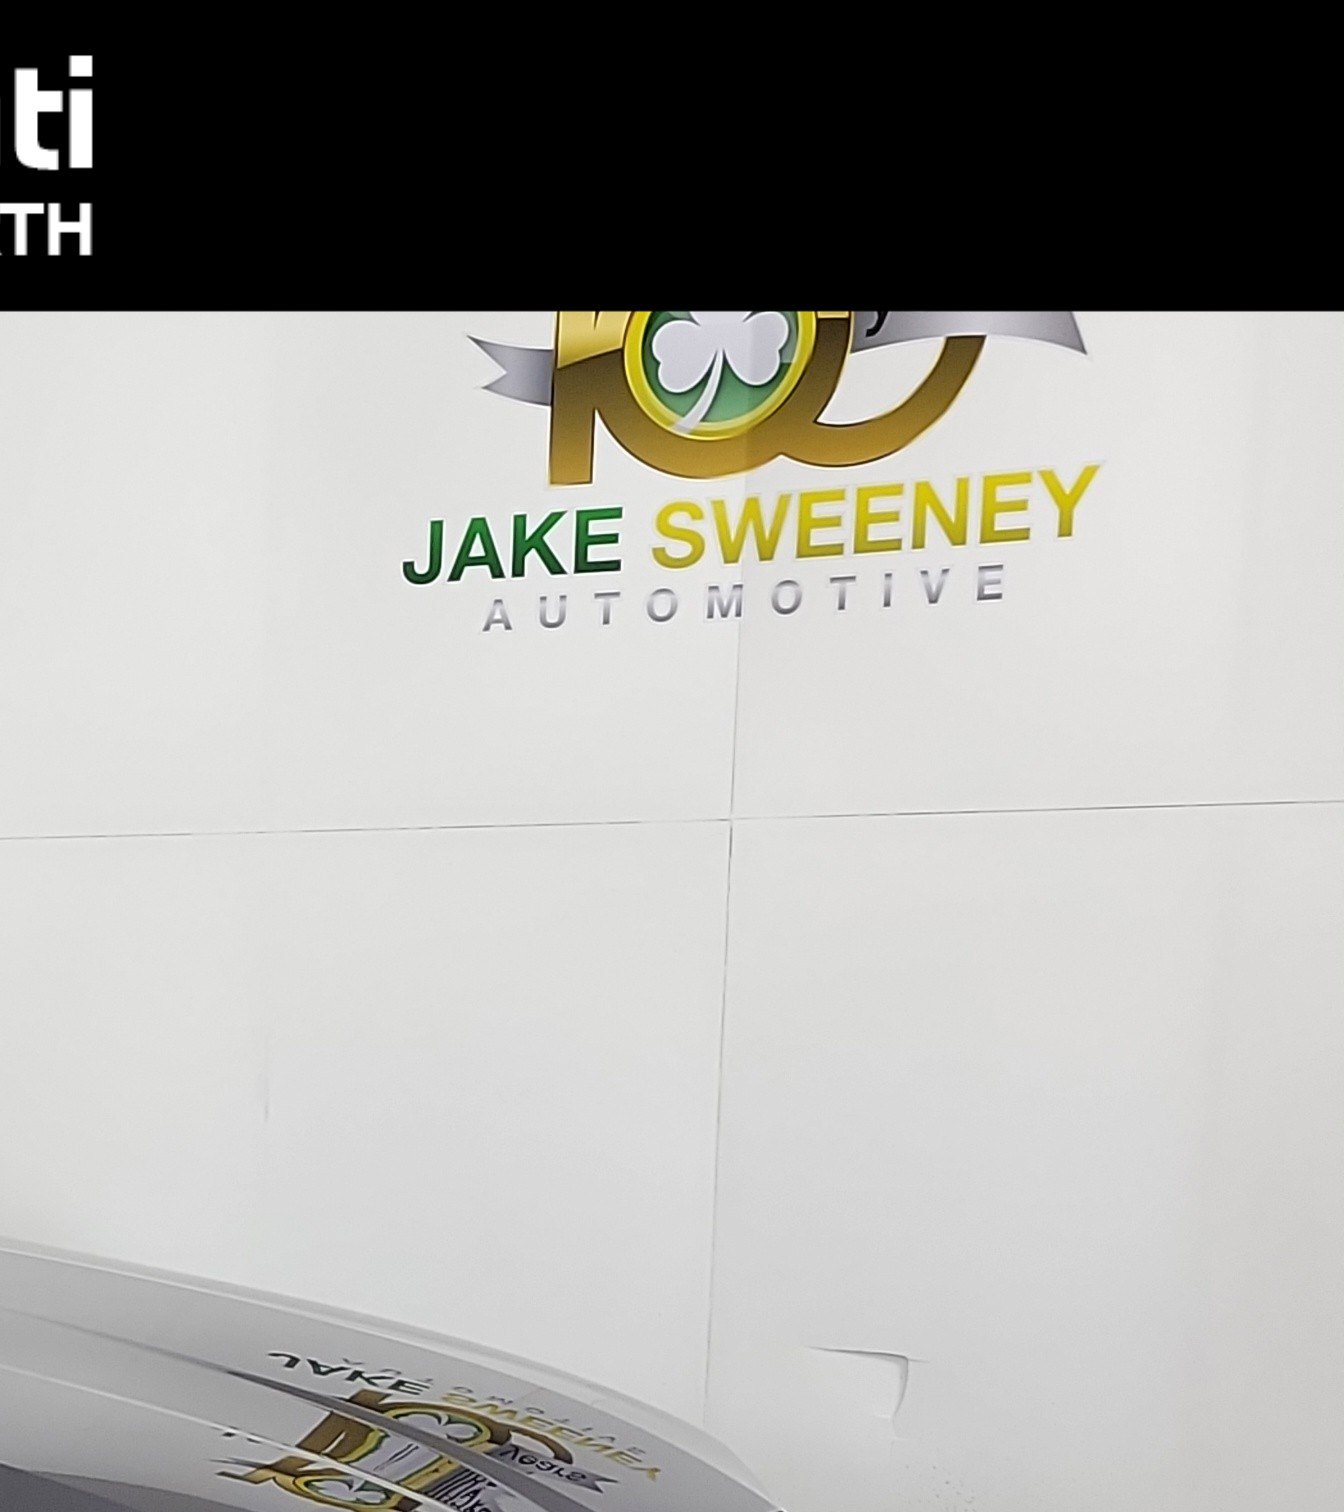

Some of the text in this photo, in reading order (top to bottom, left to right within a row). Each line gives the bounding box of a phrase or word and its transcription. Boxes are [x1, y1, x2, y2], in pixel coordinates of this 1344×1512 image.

[402, 464, 1100, 585] JAKE SWEENEY
[482, 564, 1004, 632] AUTOMOTIVE
